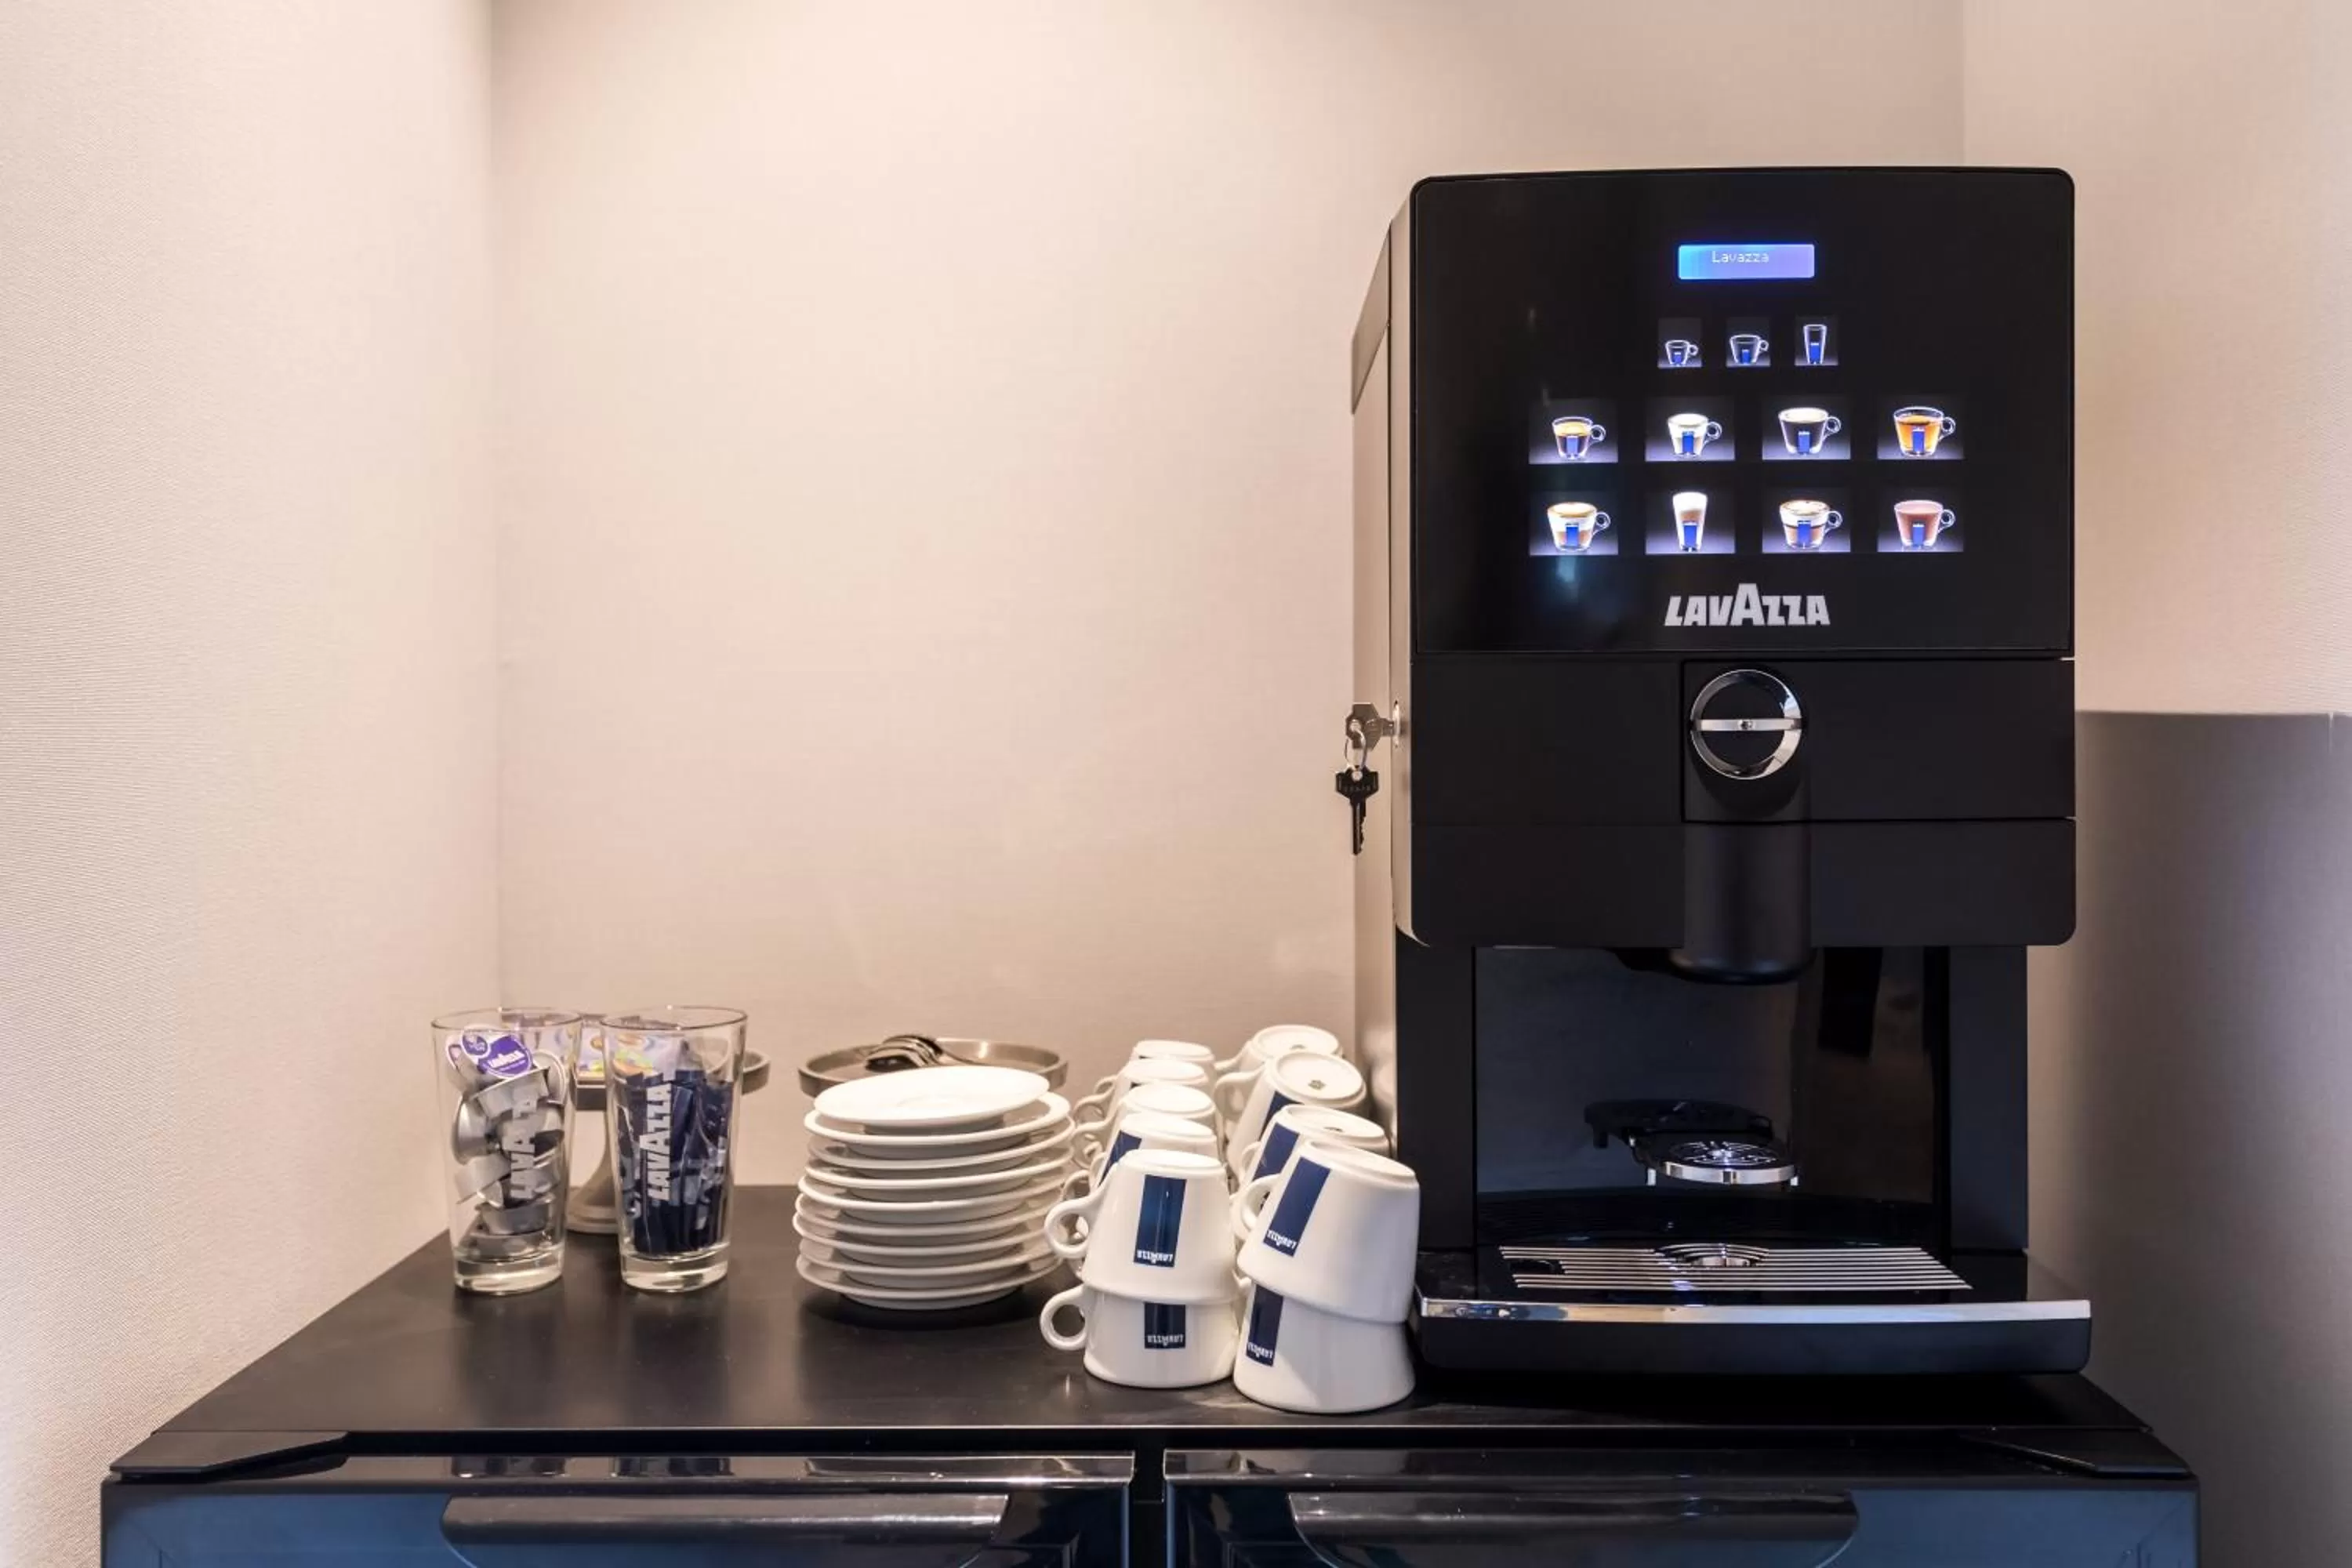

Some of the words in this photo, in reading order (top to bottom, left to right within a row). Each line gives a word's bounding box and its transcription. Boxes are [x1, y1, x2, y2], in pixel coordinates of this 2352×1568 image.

[1711, 250, 1769, 263] Lavazza
[1664, 583, 1831, 626] LAVAZZA
[501, 1084, 537, 1200] LAVAA
[639, 1083, 672, 1201] LAVAZZA
